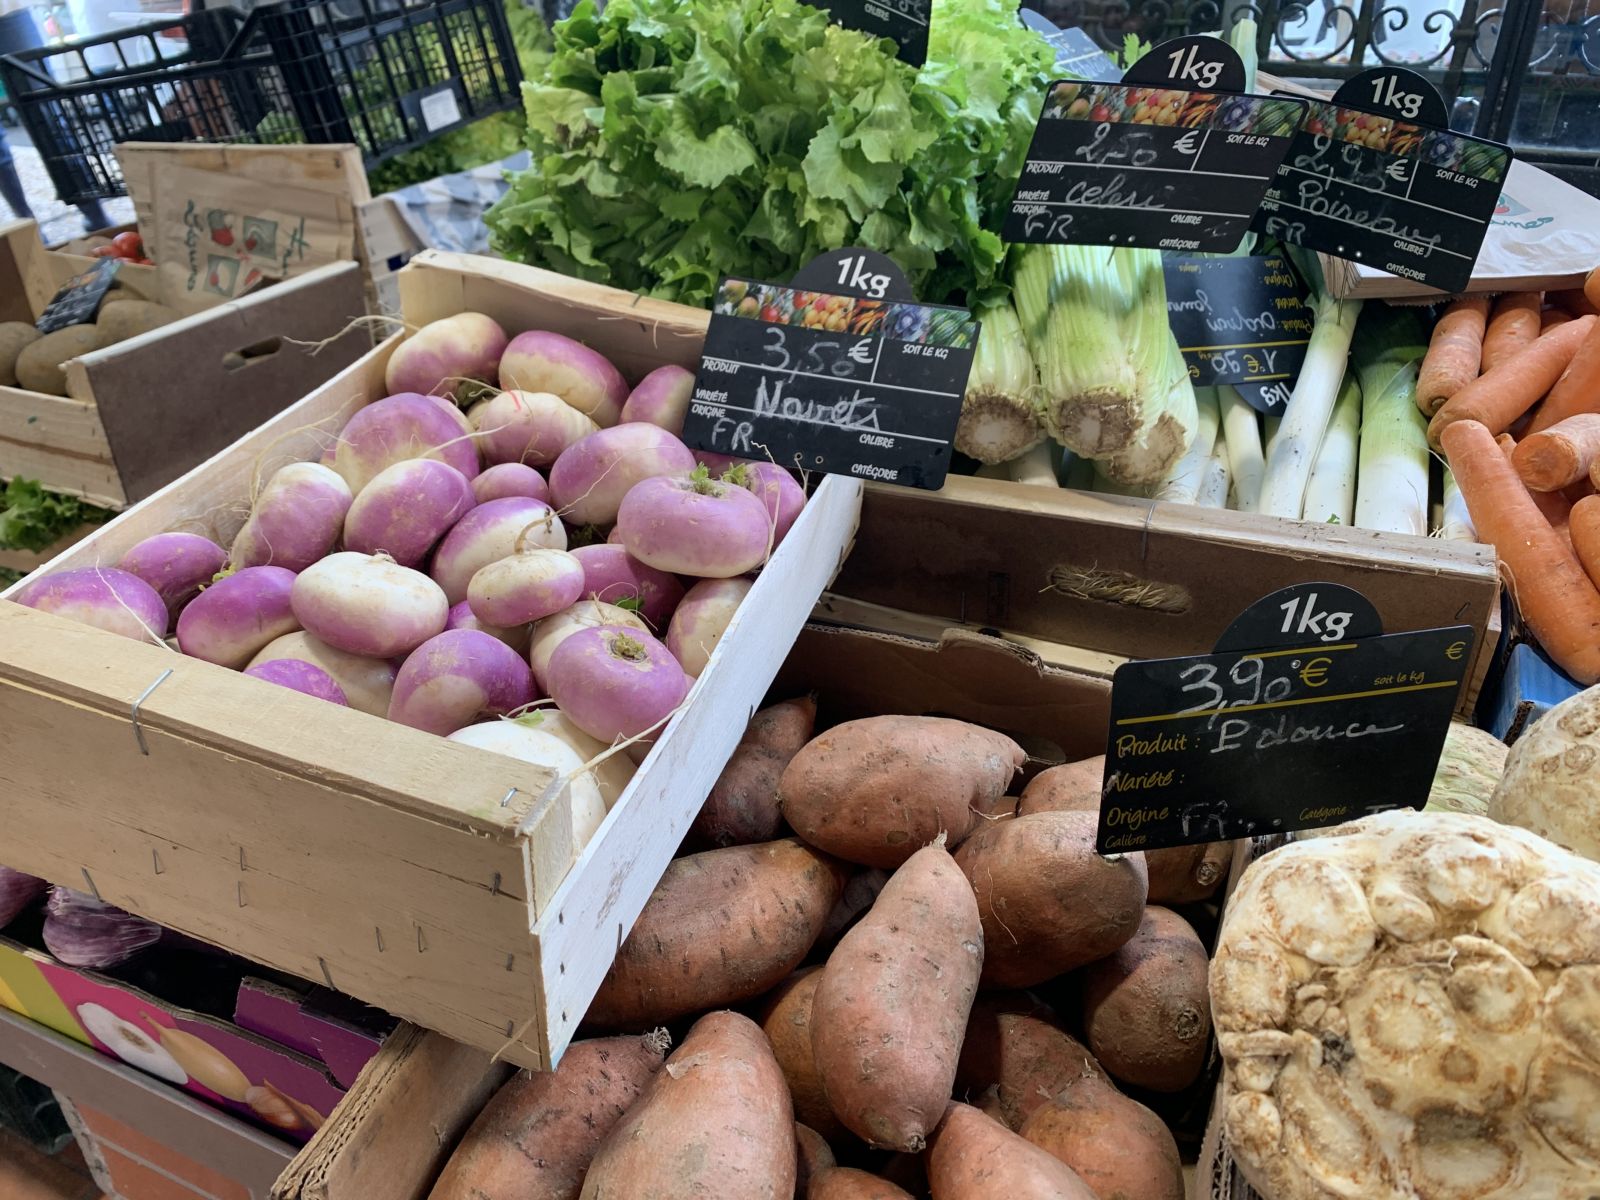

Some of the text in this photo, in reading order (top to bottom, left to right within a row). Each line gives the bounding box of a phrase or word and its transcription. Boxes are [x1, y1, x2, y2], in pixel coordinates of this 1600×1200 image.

[1167, 45, 1225, 88] 1kg
[1371, 74, 1424, 119] 1kg
[1226, 133, 1269, 148] SOIT LE KG
[1026, 162, 1065, 175] PRODUIT
[1435, 169, 1480, 189] SOIT LE KG
[1017, 189, 1050, 201] VARIÉTÉ
[1012, 203, 1047, 216] ORIGINE
[1024, 209, 1074, 240] FR
[1170, 213, 1203, 226] CALIBRE
[1158, 238, 1200, 250] CATÉGORIE
[1393, 239, 1426, 256] CALIBRE
[837, 255, 892, 298] 1kg
[1385, 262, 1427, 281] CATÉGORIE
[902, 343, 949, 359] SOIT LE KG
[702, 359, 741, 375] PRODUIT
[695, 387, 728, 402] VARIÉTÉ
[691, 404, 727, 419] ORIGINE
[711, 417, 754, 452] FR
[859, 433, 895, 448] CALIBRE
[851, 463, 899, 480] CATÉGORIE
[1280, 593, 1354, 642] 1kg
[1445, 641, 1467, 660] €
[1373, 671, 1426, 687] soit le kg
[1115, 734, 1188, 759] Produit
[1106, 807, 1169, 831] Origine
[1104, 834, 1147, 849] Calibre
